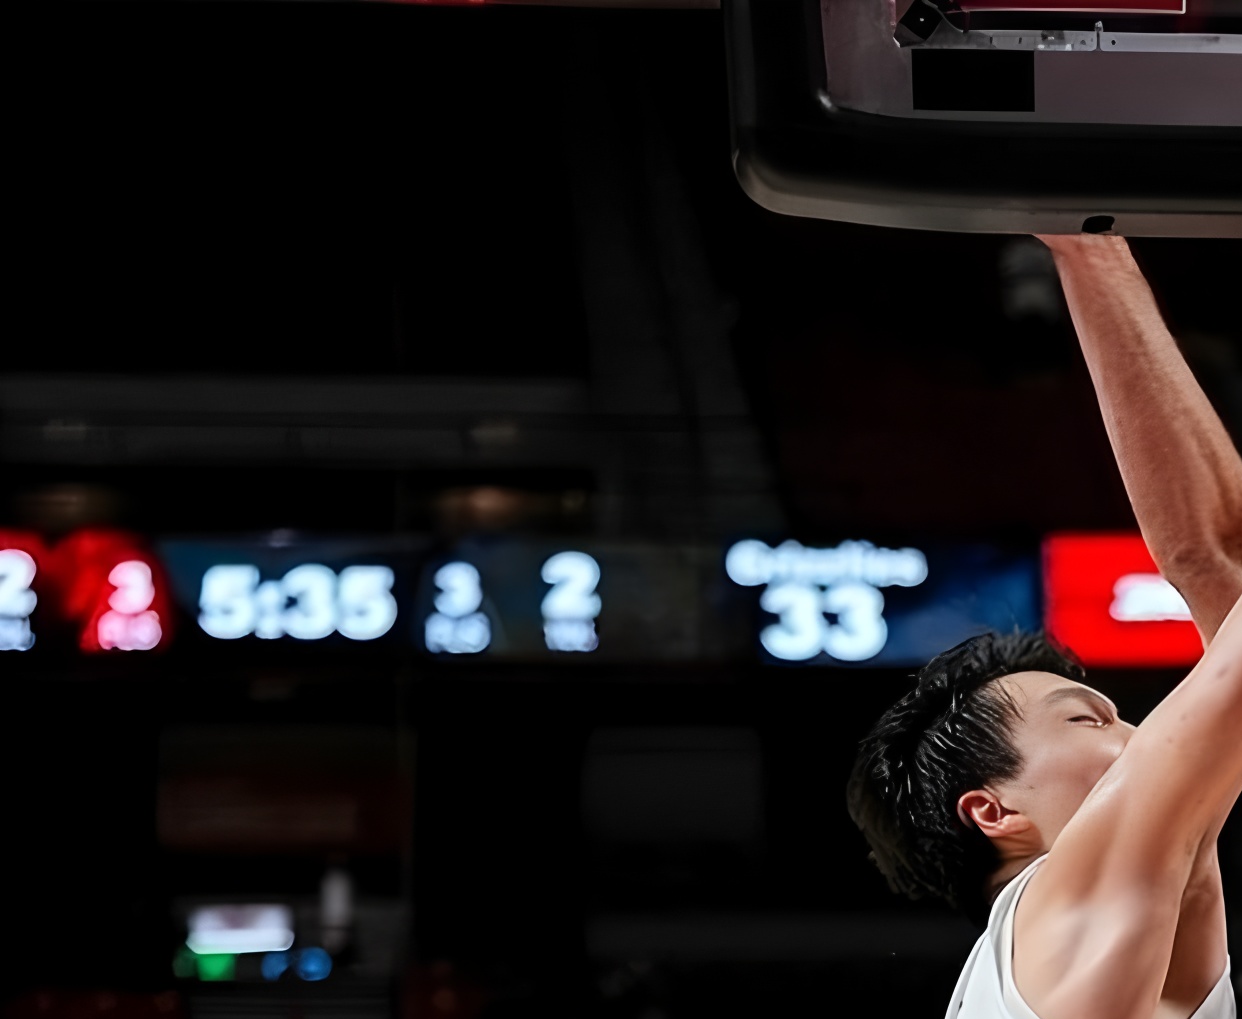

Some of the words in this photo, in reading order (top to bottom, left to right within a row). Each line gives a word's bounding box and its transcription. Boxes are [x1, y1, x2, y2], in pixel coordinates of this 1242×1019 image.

[198, 564, 397, 640] 5:35
[540, 551, 602, 618] 2
[760, 583, 888, 661] 33
